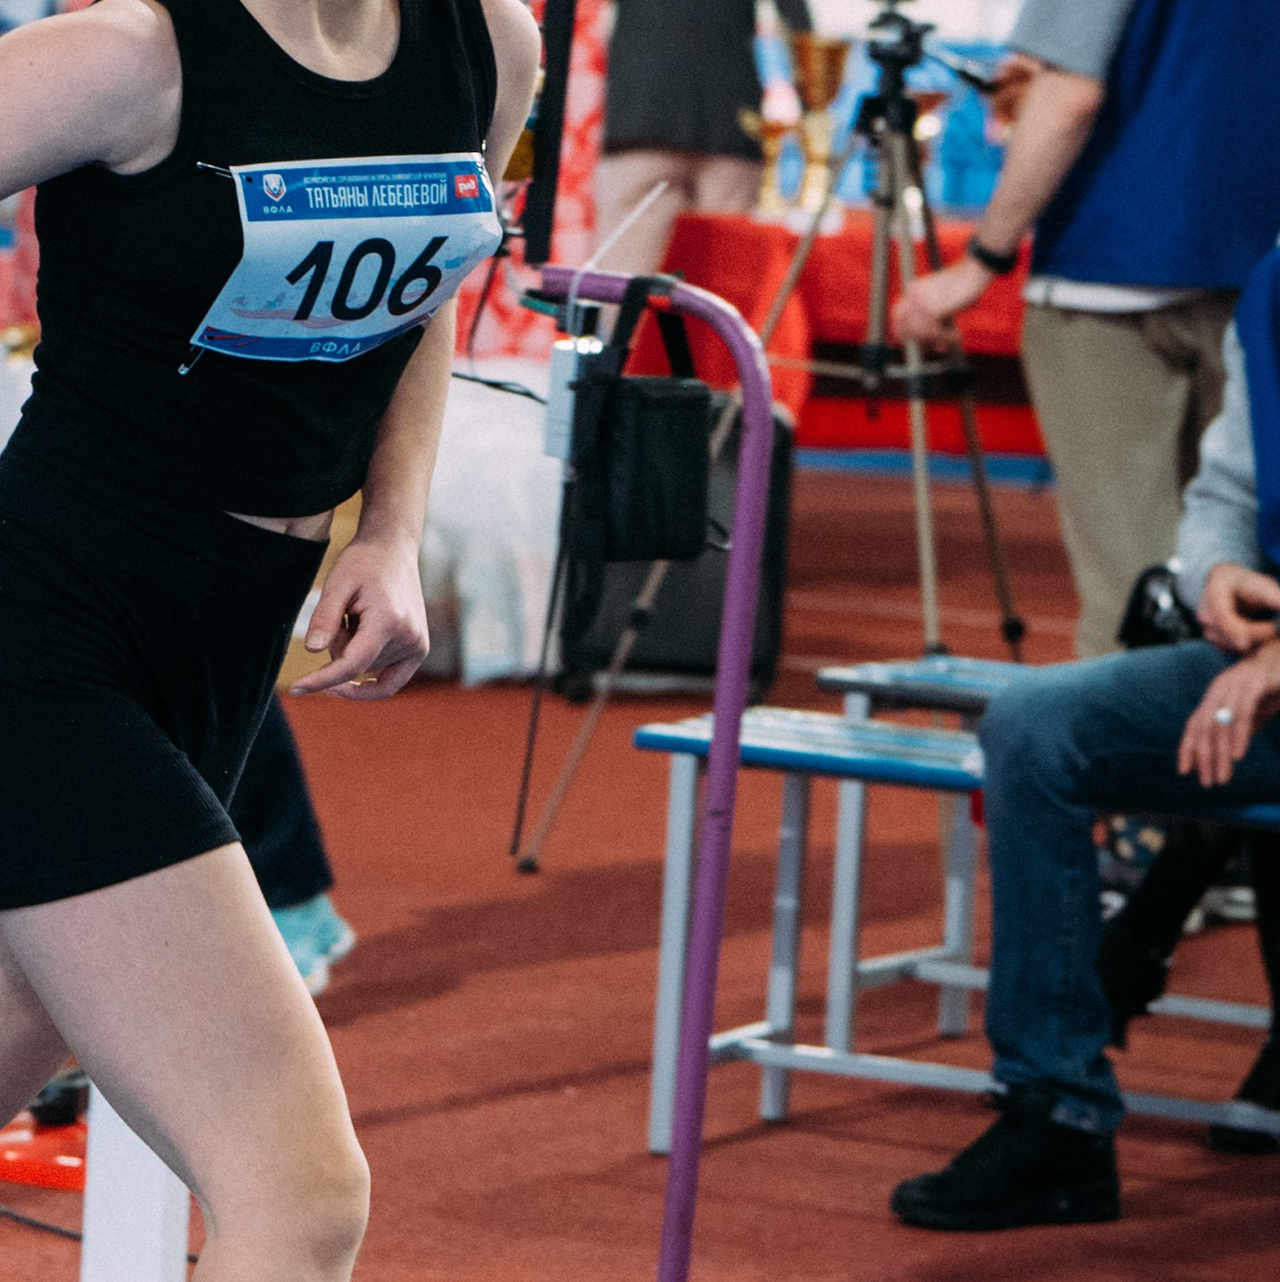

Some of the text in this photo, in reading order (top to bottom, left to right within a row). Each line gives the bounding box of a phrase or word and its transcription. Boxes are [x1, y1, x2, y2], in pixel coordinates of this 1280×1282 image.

[305, 179, 448, 209] ТАТЬЯНЫ ЛЕБЕДЕВОЙ
[285, 236, 449, 321] 106
[309, 341, 361, 355] ВФЛА
